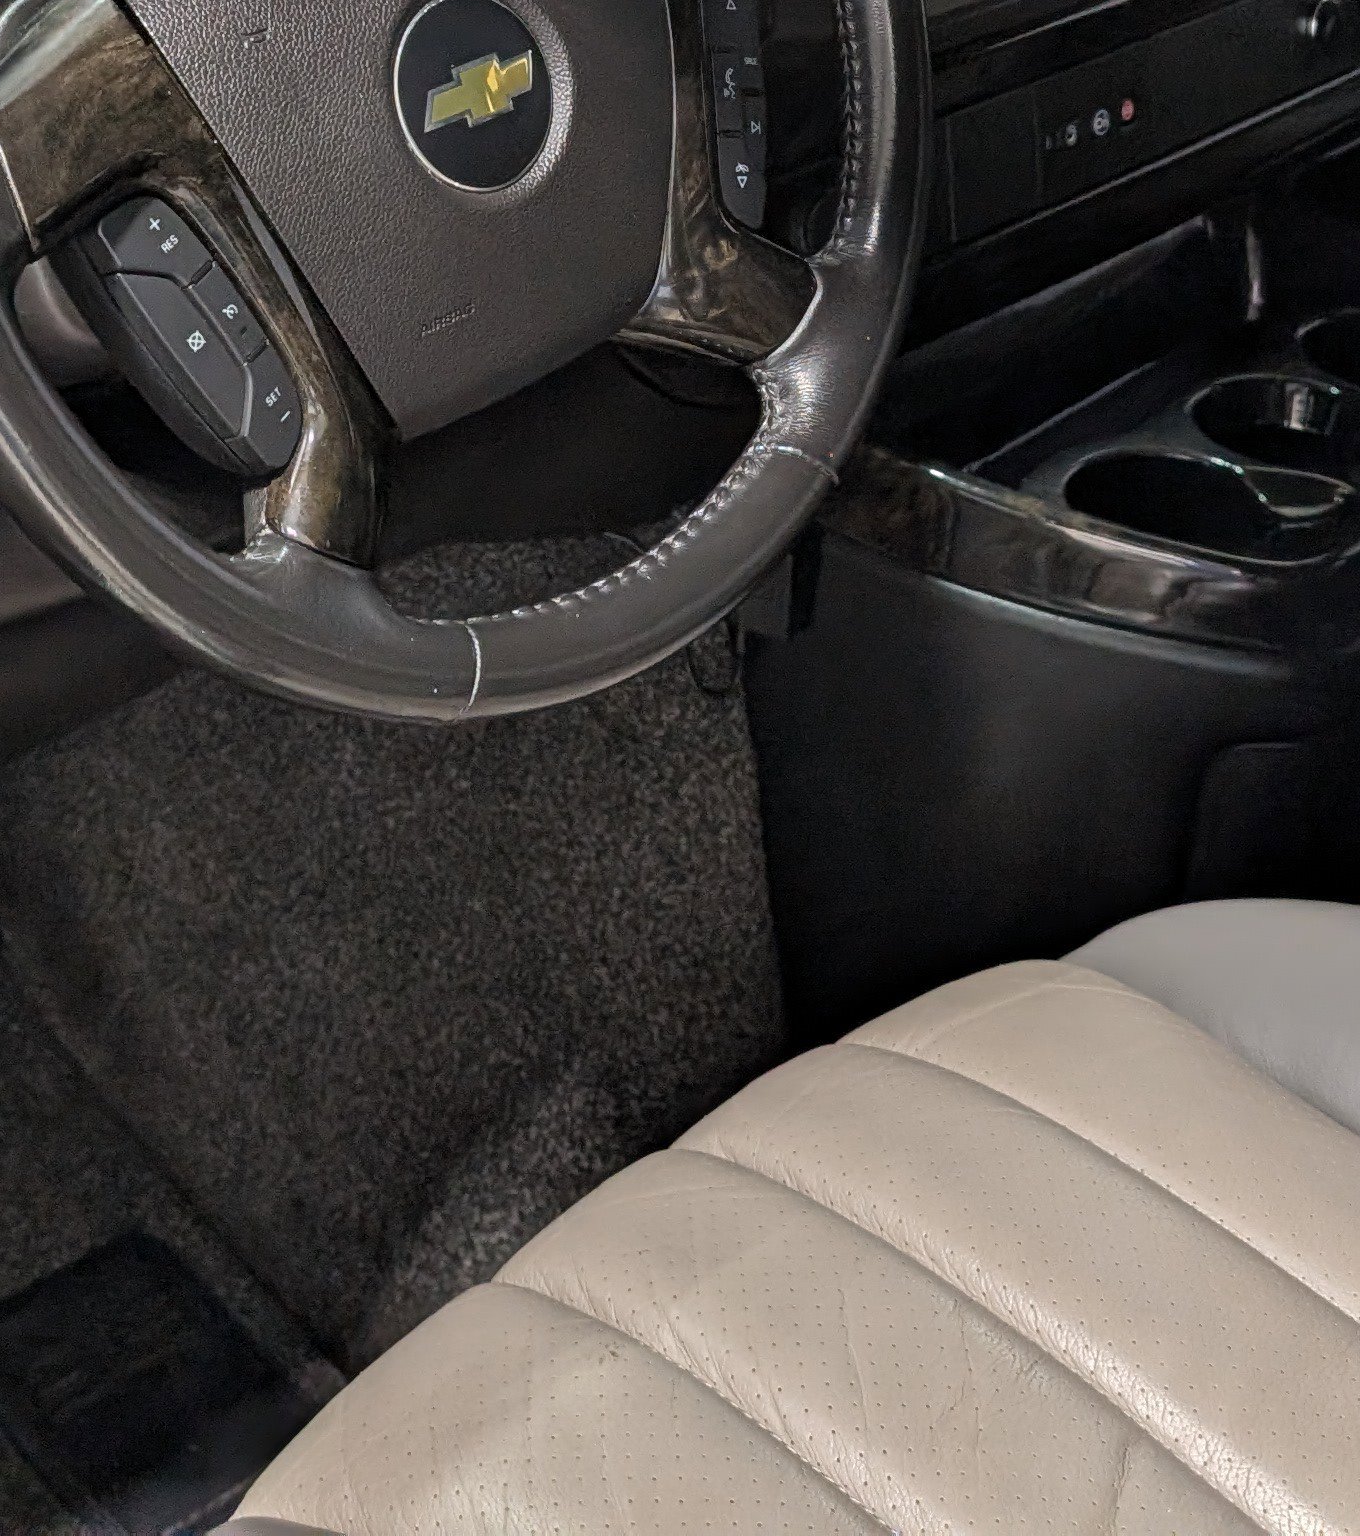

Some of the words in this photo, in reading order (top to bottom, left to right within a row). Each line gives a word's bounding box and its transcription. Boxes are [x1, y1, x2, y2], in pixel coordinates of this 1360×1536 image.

[160, 234, 179, 254] RES
[422, 303, 476, 338] AIRBAG
[265, 386, 282, 407] SET
